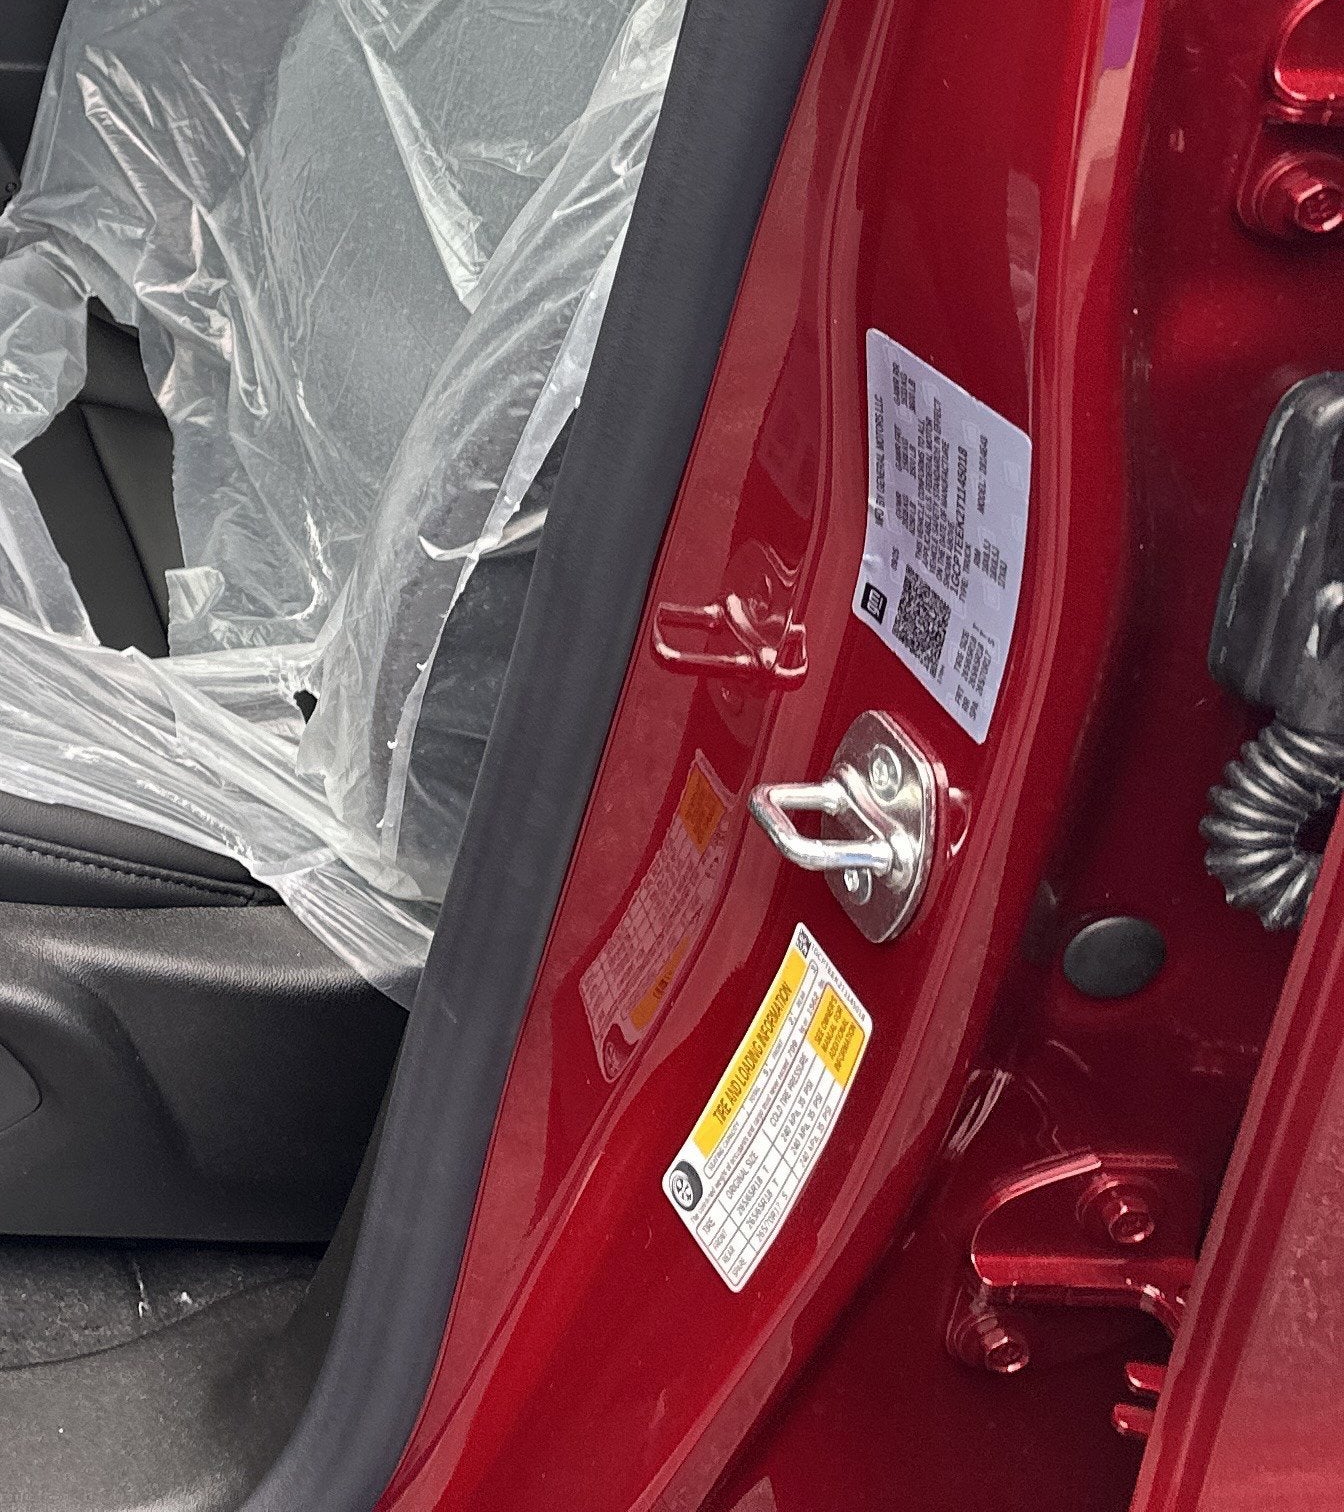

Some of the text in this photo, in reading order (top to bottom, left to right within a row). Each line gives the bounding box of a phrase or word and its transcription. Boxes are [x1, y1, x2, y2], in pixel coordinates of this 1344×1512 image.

[874, 392, 883, 415] LLC
[875, 411, 884, 453] MOTORS
[876, 448, 884, 494] GENERAL
[949, 444, 967, 596] 1GCPTEEK2T1145018
[963, 540, 971, 575] TRUCK
[787, 1016, 794, 1026] 2
[813, 1026, 824, 1045] SEE
[821, 1004, 843, 1053] MANUAL FOR
[828, 1016, 849, 1060] ADDITIONAL
[712, 979, 792, 1127] TIRE AND LOADING INFORMATION
[834, 1021, 856, 1072] INFORMATION
[725, 1164, 749, 1201] ORIGINAL
[745, 1149, 758, 1169] SIZE
[768, 1103, 783, 1128] COLD
[779, 1087, 791, 1108] TIRE
[787, 1051, 808, 1093] PRESSURE
[713, 1228, 727, 1253] FRONT
[763, 1163, 769, 1174] T
[780, 1123, 791, 1143] 240
[797, 1094, 806, 1109] 35
[802, 1078, 814, 1097] PSI
[781, 1189, 788, 1199] S
[799, 1149, 810, 1169] 240
[816, 1120, 824, 1134] 35
[821, 1104, 832, 1122] PSI
[722, 1244, 734, 1264] REAR
[772, 1176, 779, 1188] T
[790, 1136, 801, 1156] 240
[806, 1107, 815, 1122] 35
[812, 1091, 823, 1110] PSI
